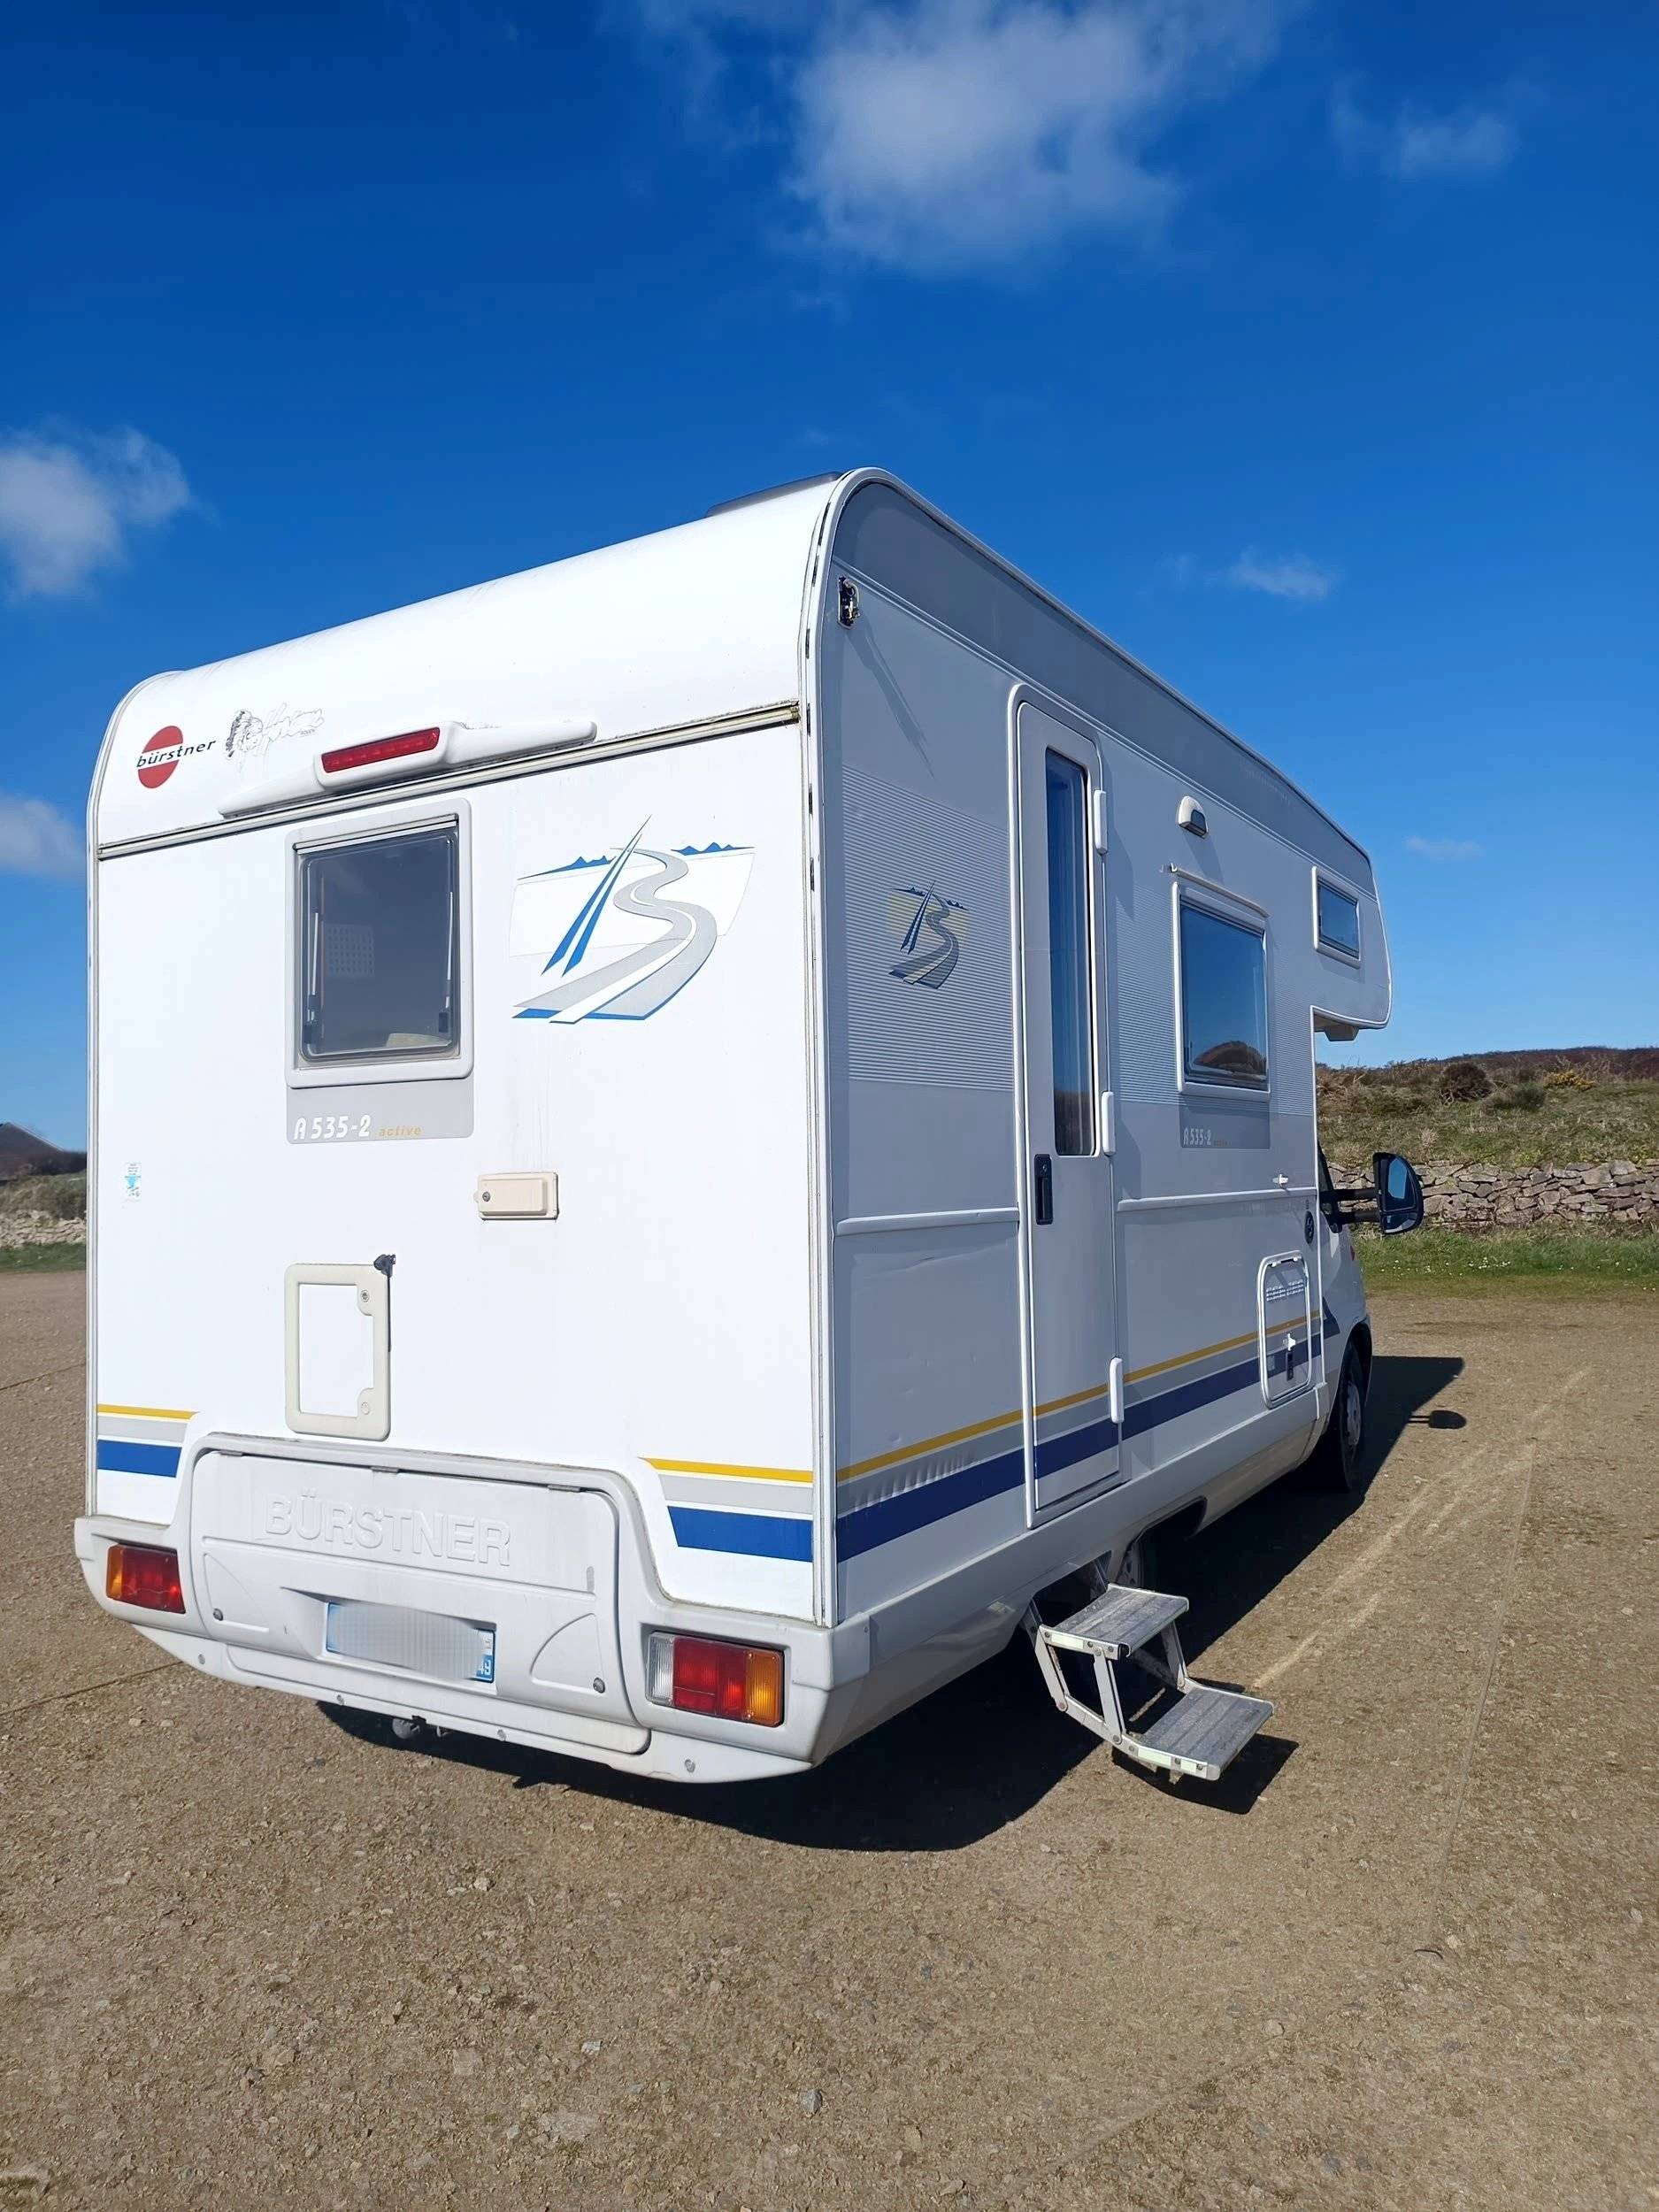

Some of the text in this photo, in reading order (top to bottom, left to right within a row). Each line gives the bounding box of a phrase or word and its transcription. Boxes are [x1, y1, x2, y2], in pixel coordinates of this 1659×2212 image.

[136, 739, 216, 768] bürstner
[294, 1114, 422, 1141] A 535-2 active
[265, 1491, 511, 1567] BÜRSTNER
